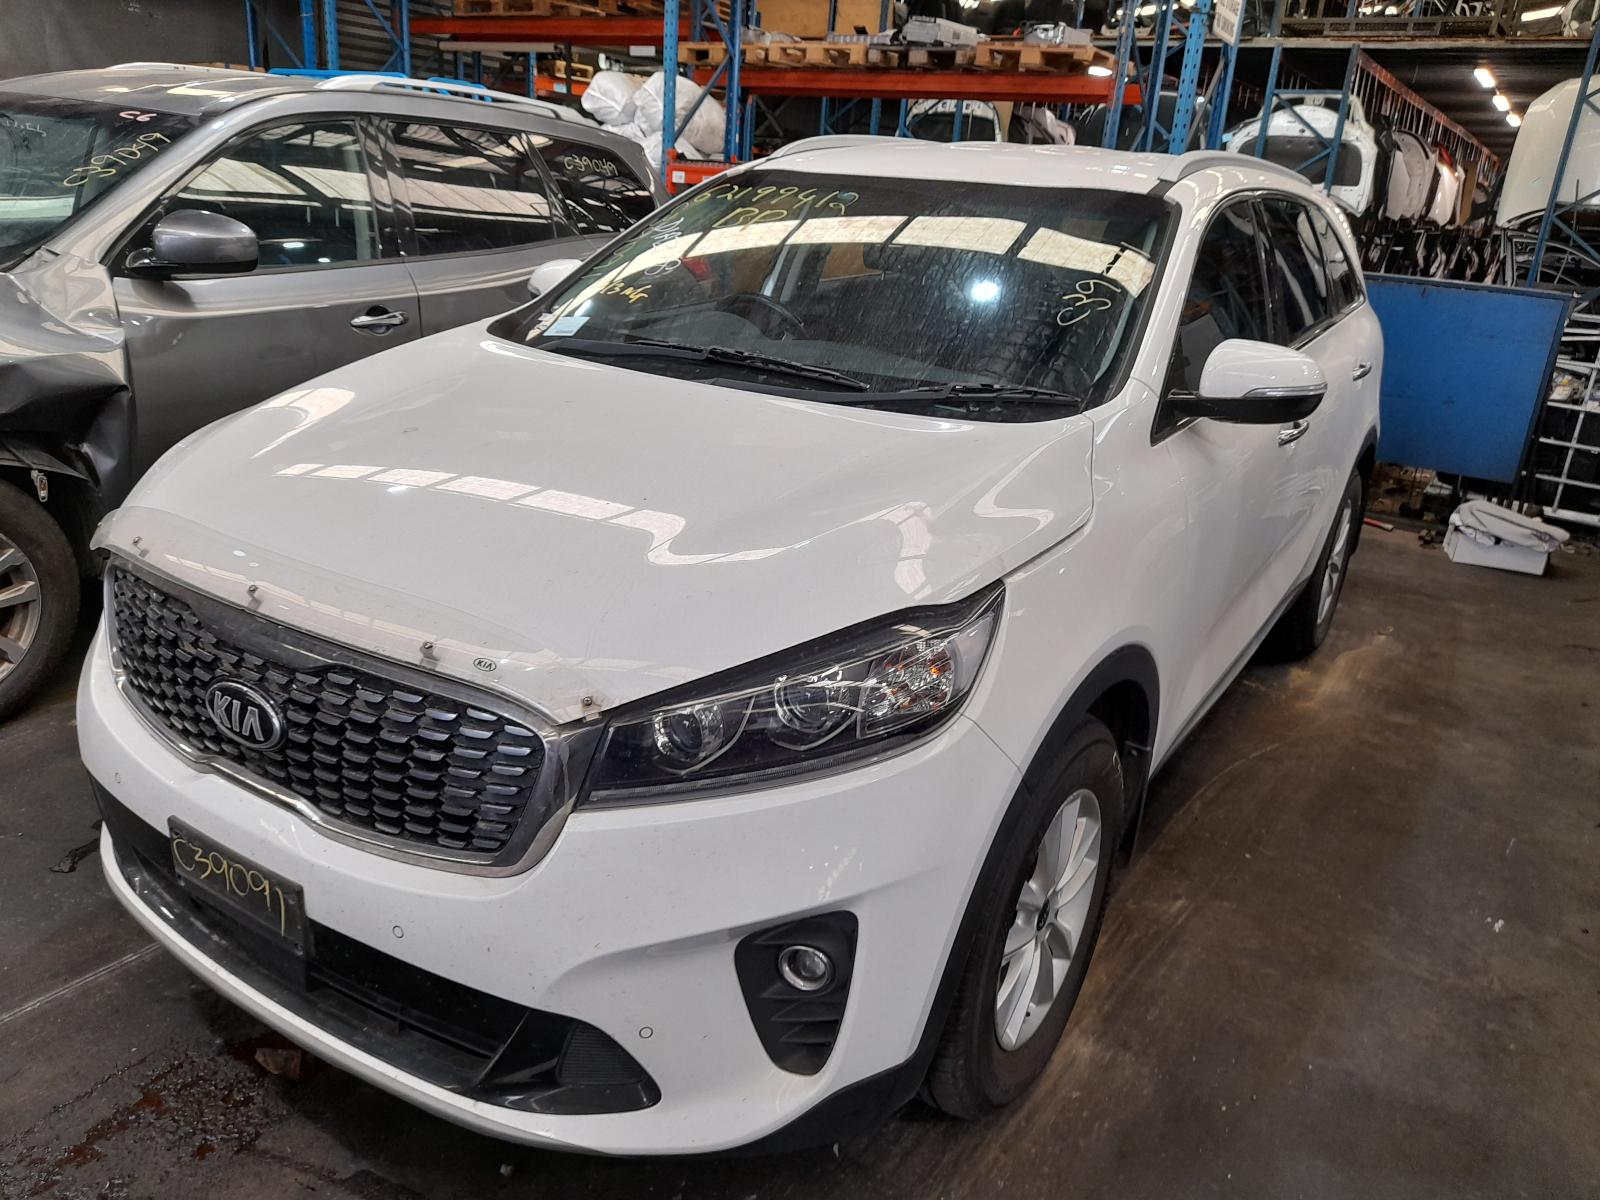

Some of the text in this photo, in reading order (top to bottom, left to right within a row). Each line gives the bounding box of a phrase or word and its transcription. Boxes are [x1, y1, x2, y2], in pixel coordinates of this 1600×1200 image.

[119, 110, 158, 122] C6
[563, 153, 619, 177] C39049
[476, 659, 493, 671] KIA
[213, 690, 265, 742] KIA
[172, 838, 286, 937] C39091
